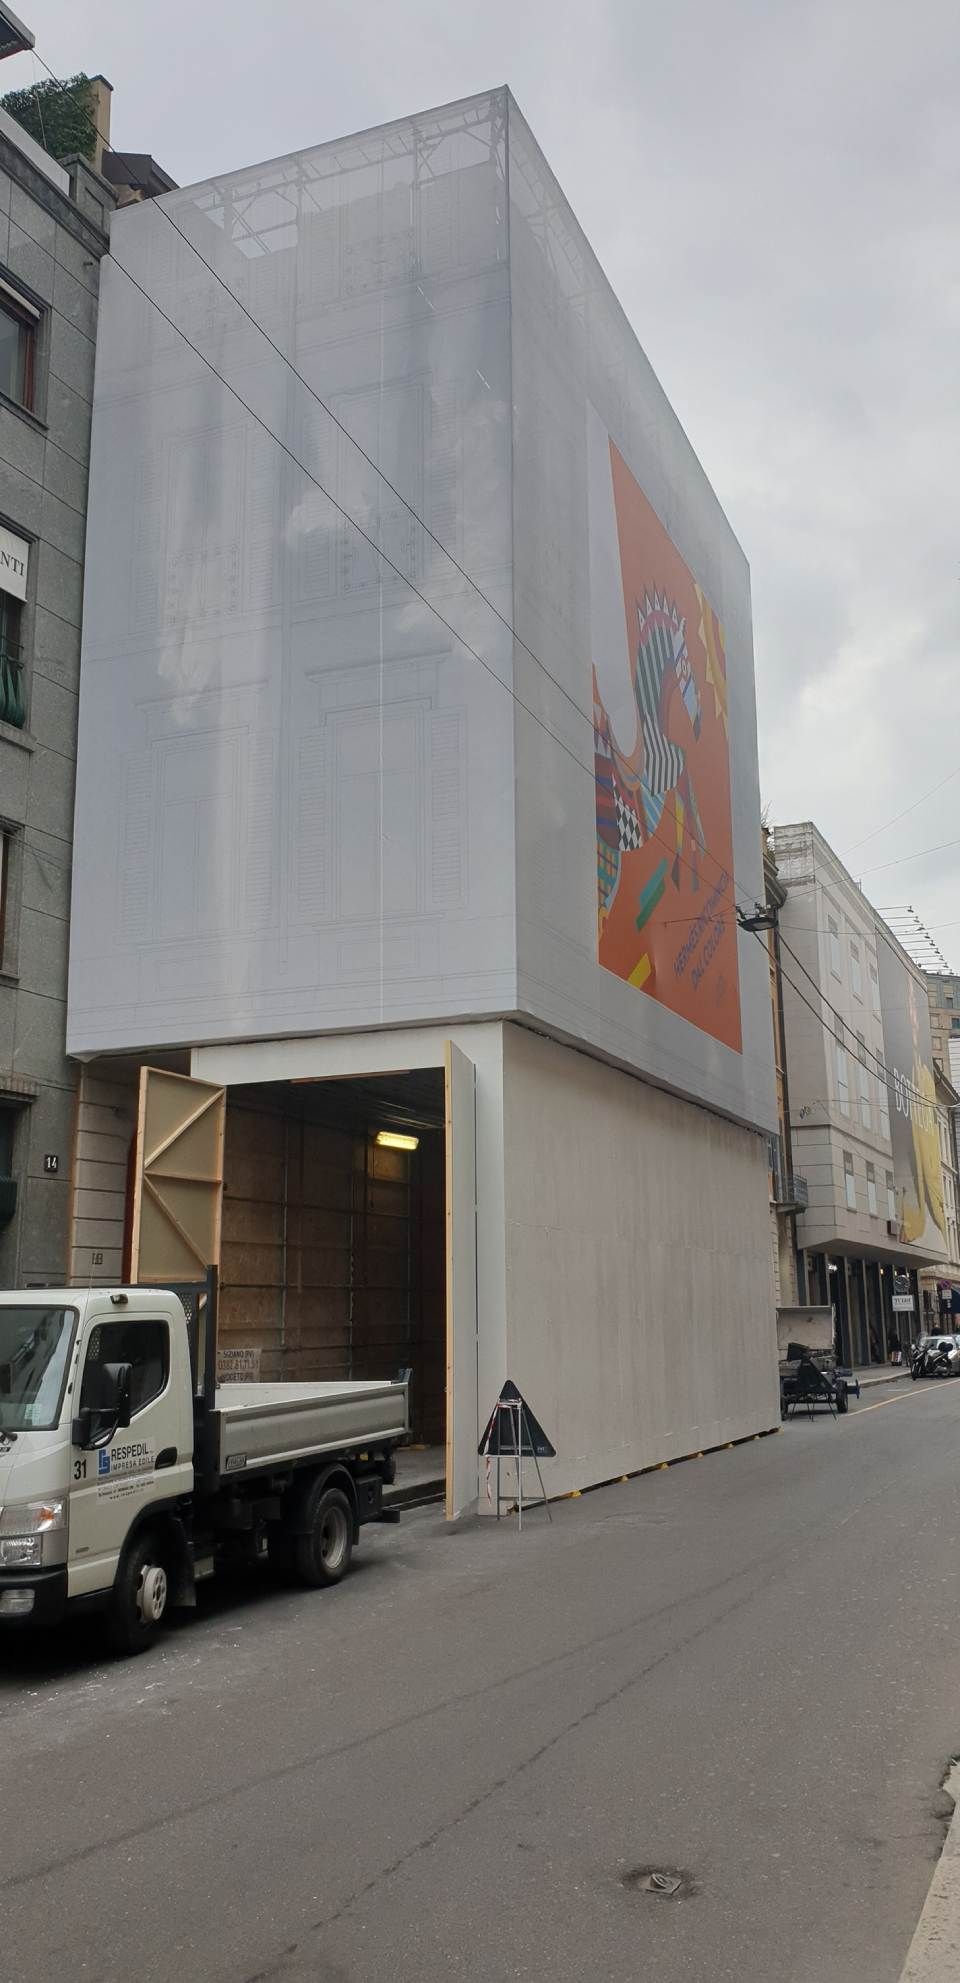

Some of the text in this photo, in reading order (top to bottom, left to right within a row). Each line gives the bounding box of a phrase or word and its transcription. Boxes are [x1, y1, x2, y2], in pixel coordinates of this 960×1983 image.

[46, 1157, 57, 1168] 14
[111, 1443, 149, 1461] RESPEDIL
[73, 1459, 87, 1480] 31
[110, 1461, 137, 1472] IMPRESA
